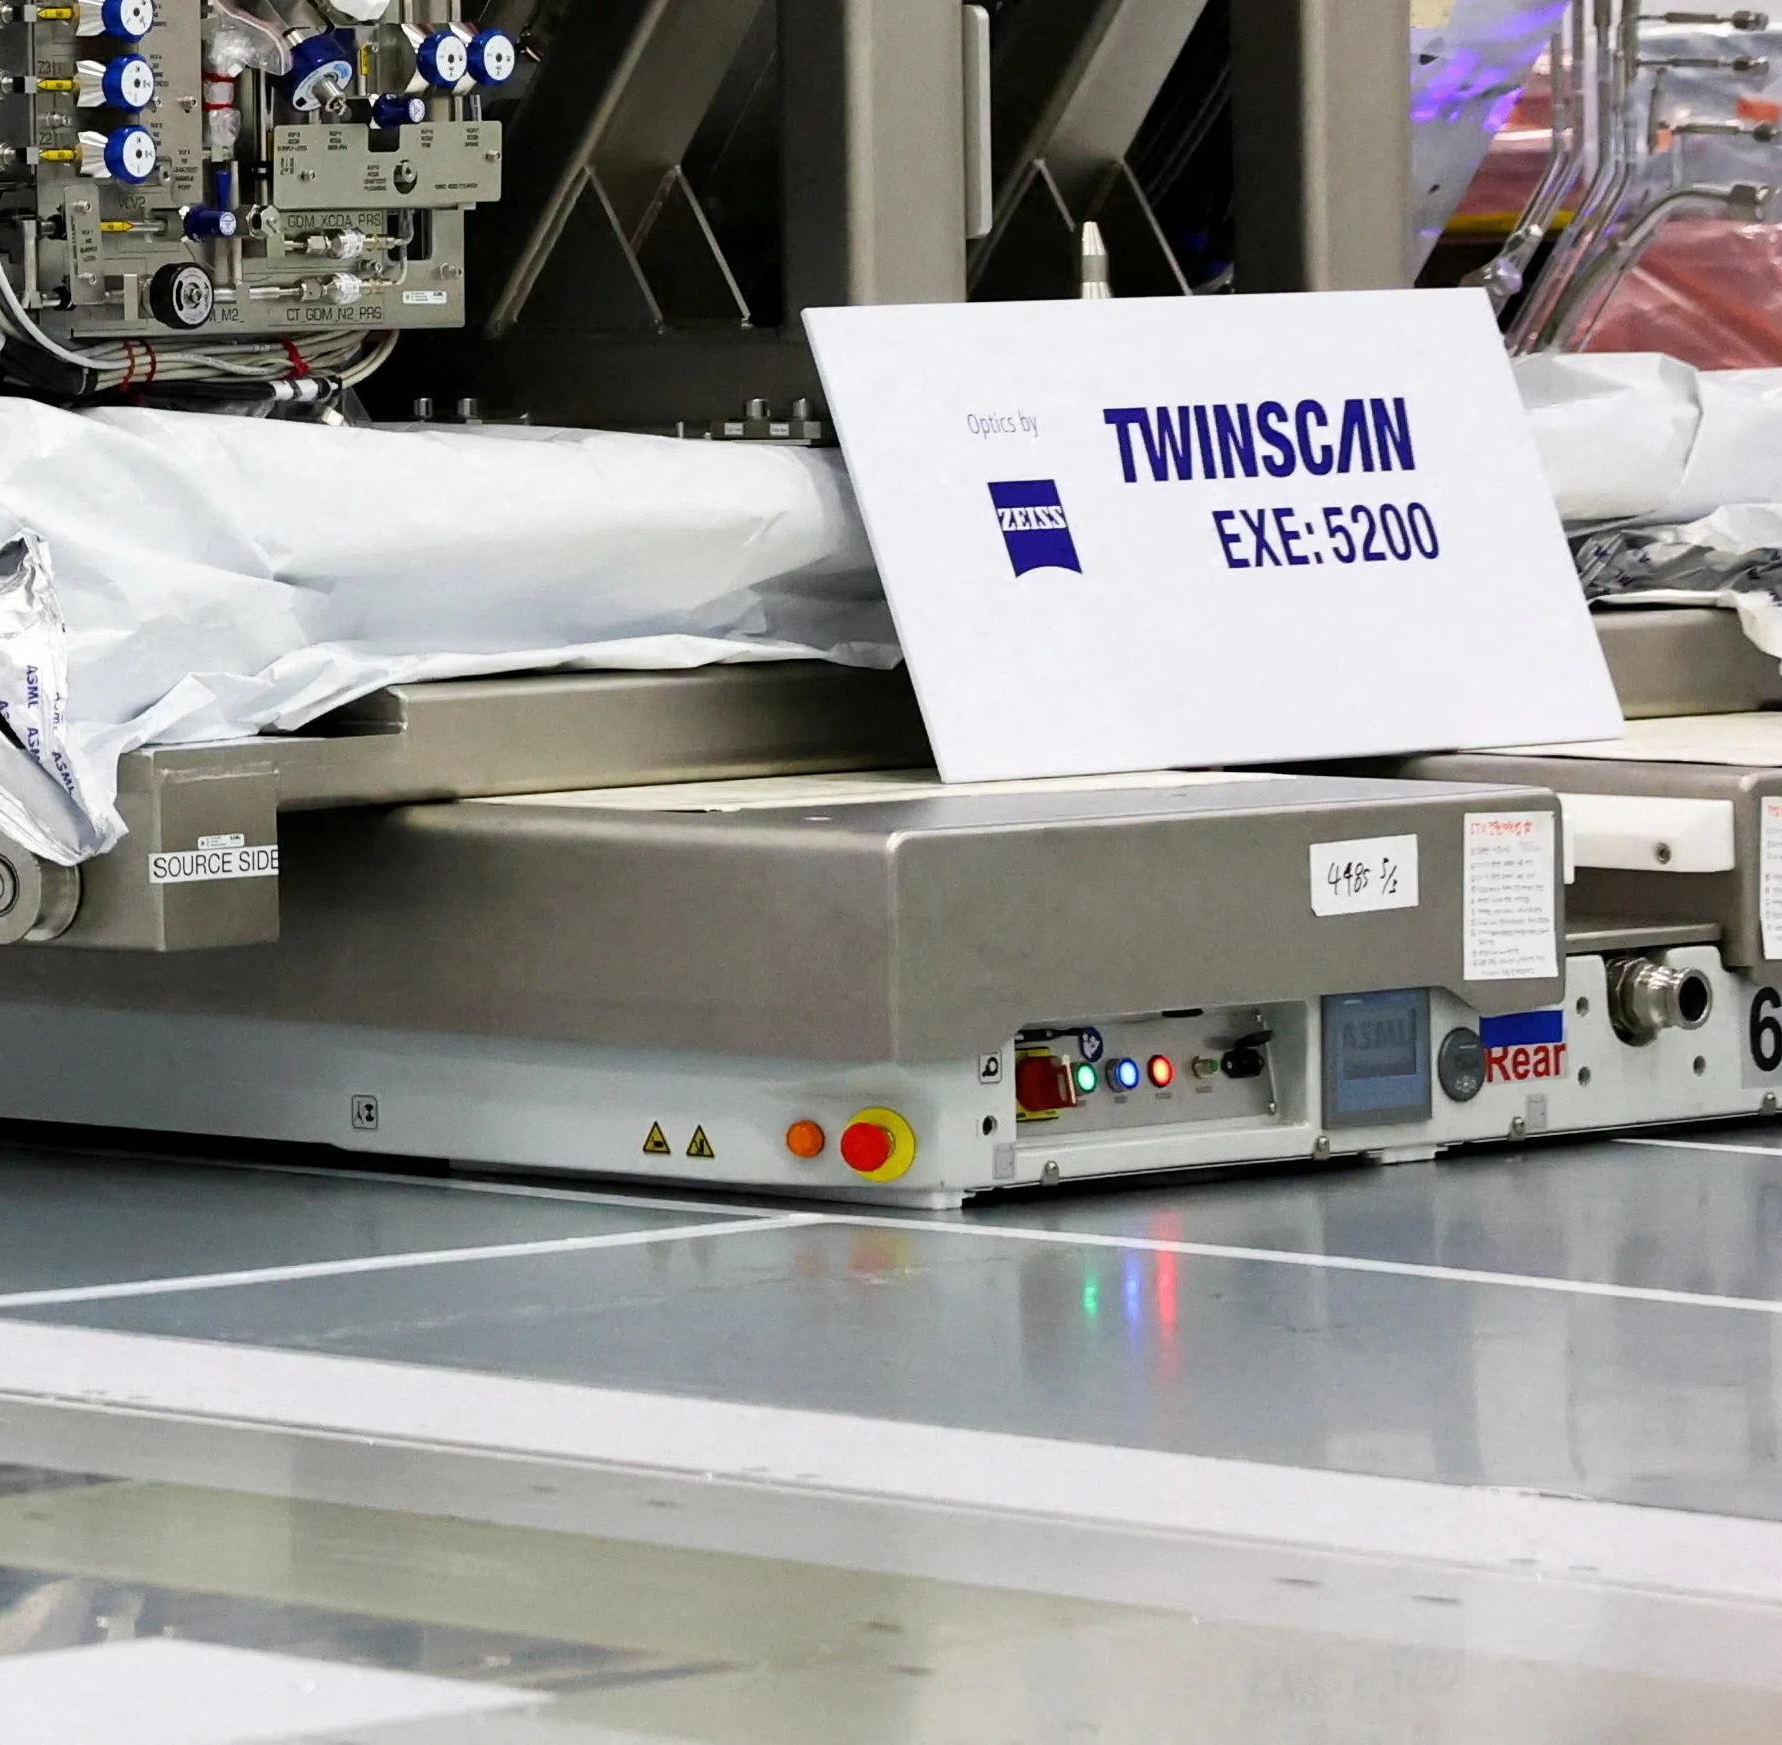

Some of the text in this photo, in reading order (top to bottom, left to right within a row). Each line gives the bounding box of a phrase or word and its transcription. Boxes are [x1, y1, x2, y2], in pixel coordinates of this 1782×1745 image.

[39, 132, 52, 145] Z2
[966, 411, 1038, 439] Optics by
[1103, 397, 1416, 483] TWINSCAN
[997, 505, 1067, 531] ZEISS
[25, 664, 38, 709] ASML
[26, 727, 41, 763] ASM
[51, 751, 75, 794] ASML
[154, 849, 279, 878] SOURCE SIDE
[1485, 1043, 1567, 1083] Rear
